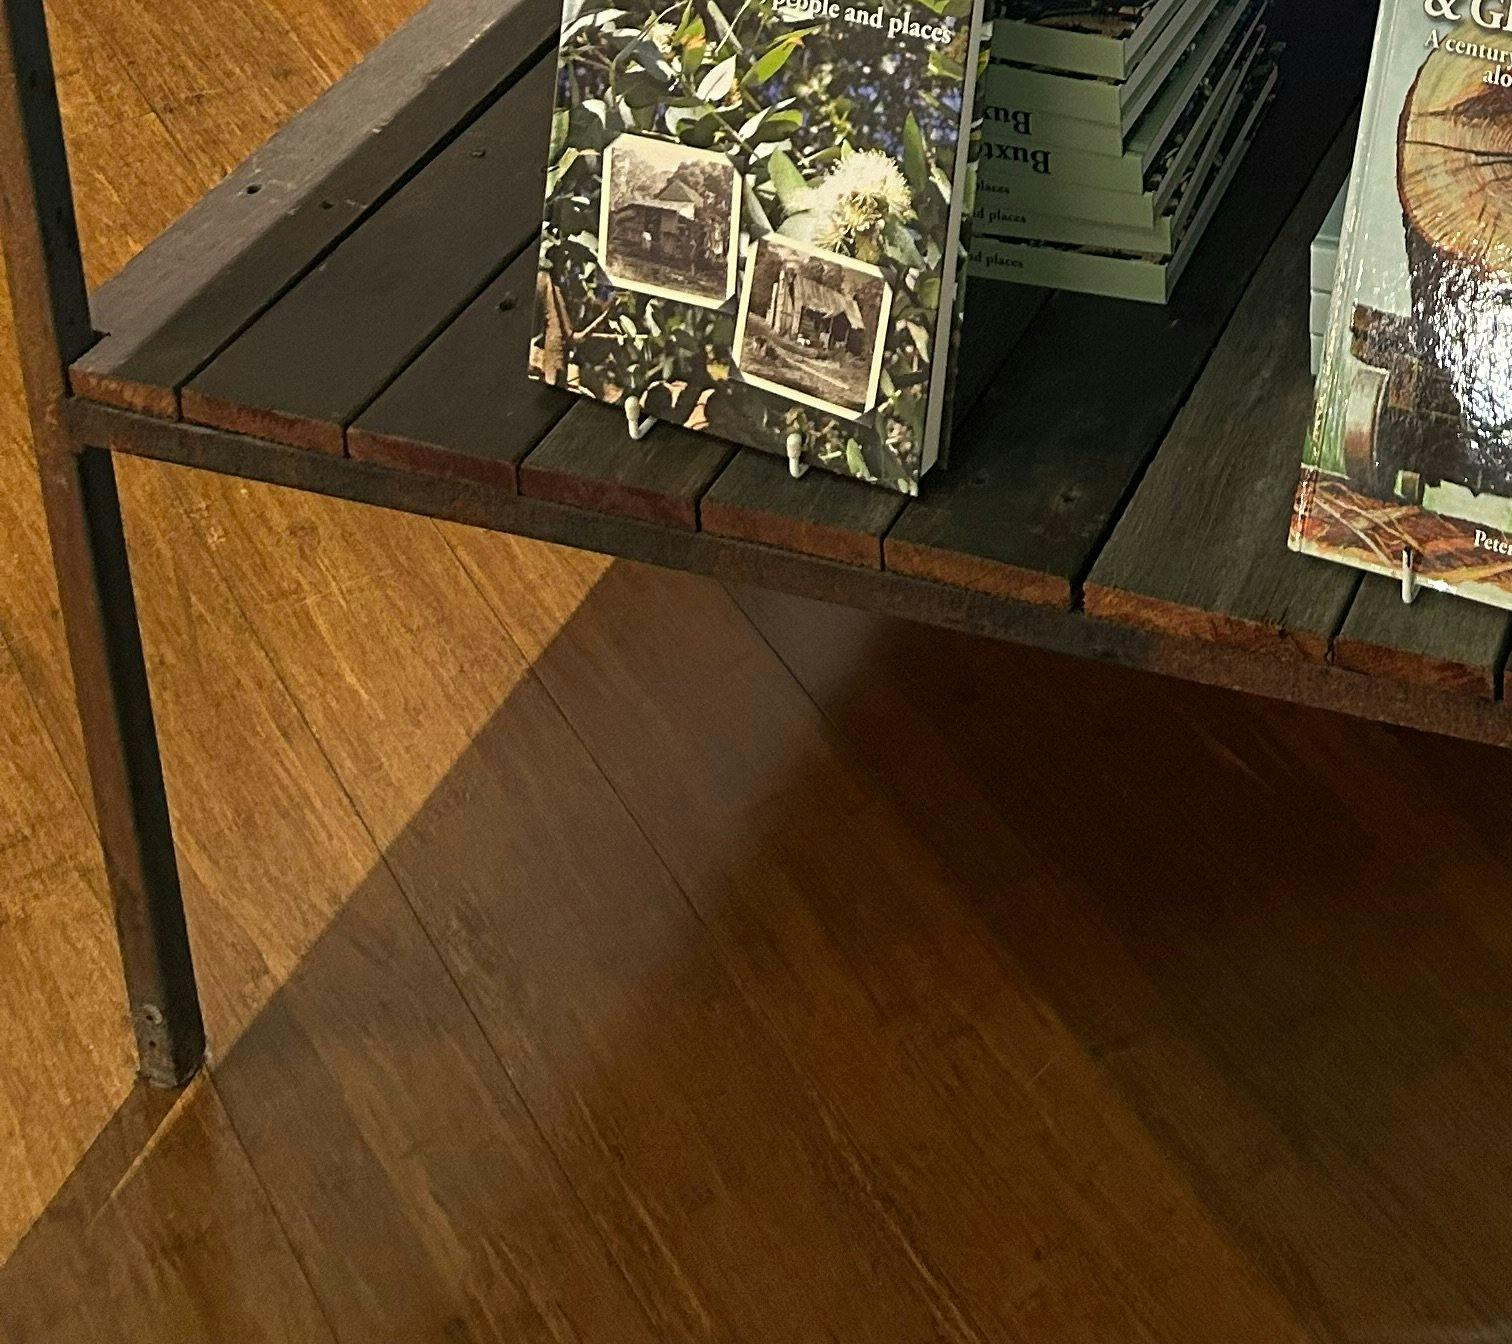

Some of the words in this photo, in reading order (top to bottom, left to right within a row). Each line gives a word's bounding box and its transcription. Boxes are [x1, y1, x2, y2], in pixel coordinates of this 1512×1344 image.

[844, 7, 883, 30] and
[888, 10, 953, 45] places
[1424, 30, 1443, 50] A
